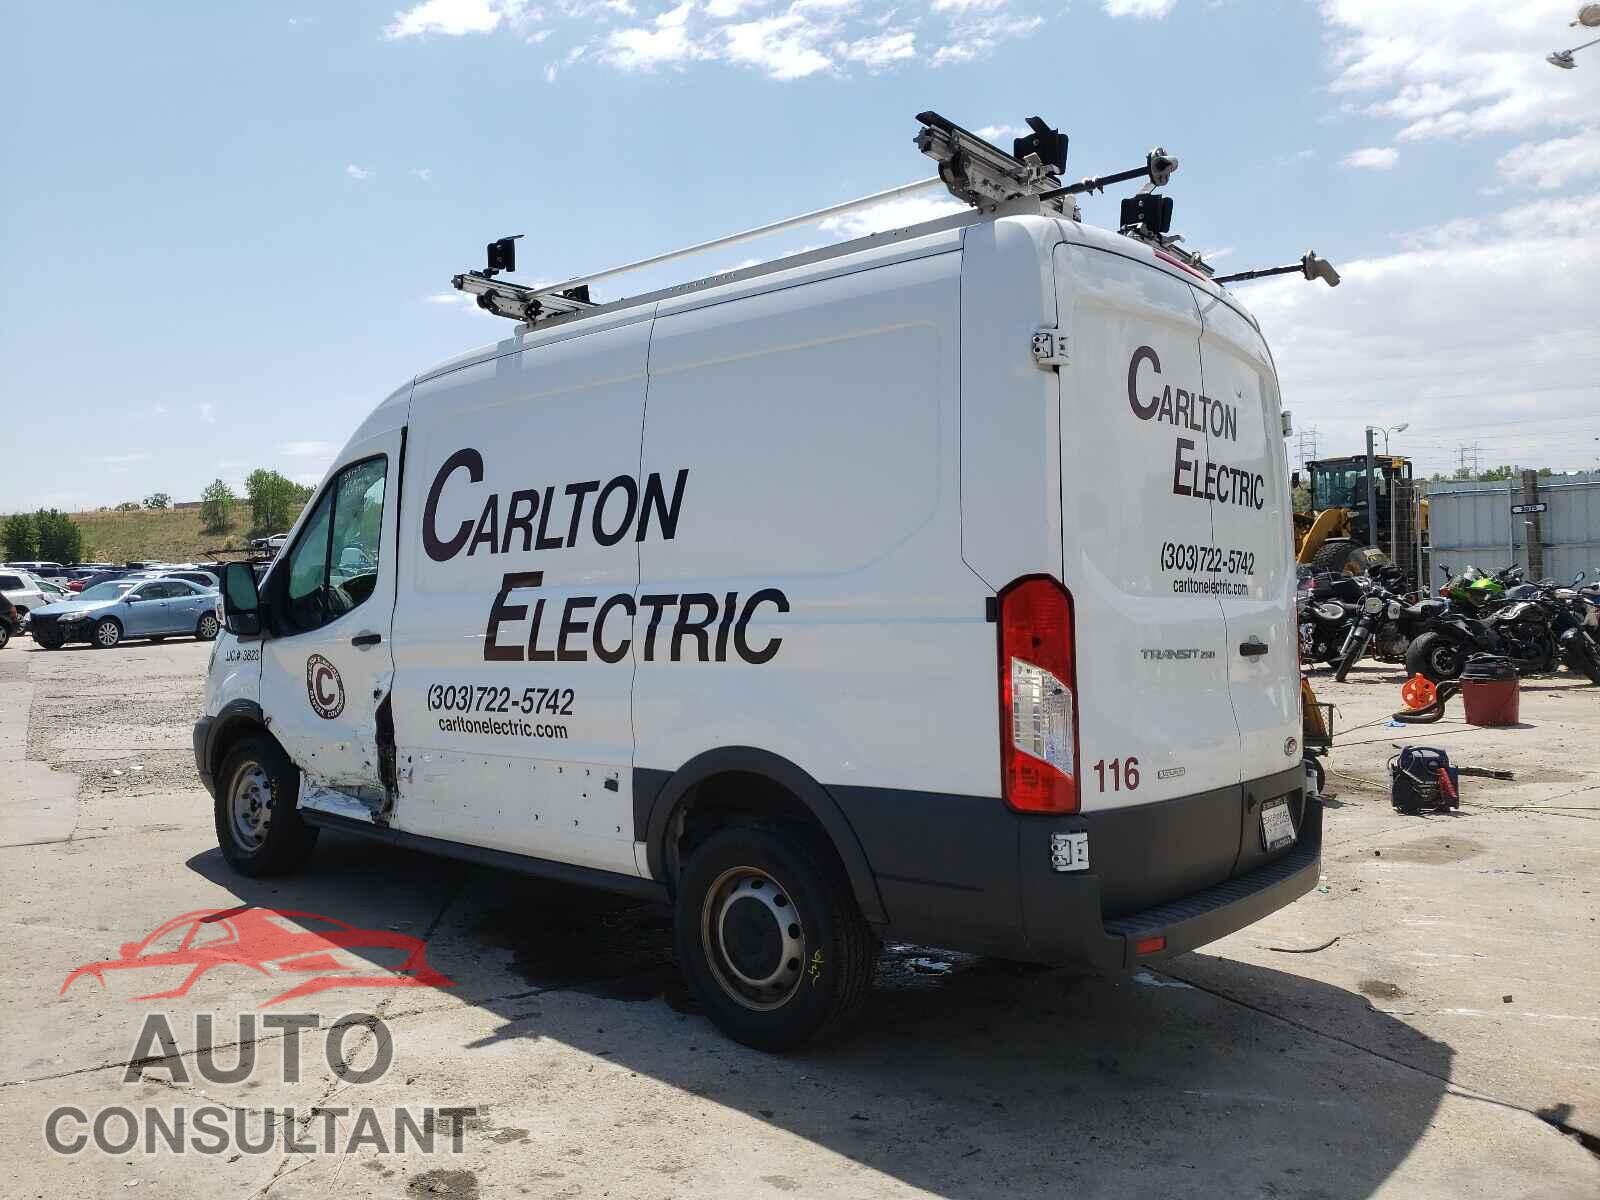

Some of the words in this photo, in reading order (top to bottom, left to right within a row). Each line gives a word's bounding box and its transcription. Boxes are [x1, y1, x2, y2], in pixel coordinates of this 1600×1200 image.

[1127, 345, 1237, 442] CARLTON
[1172, 437, 1264, 511] ELECTRIC
[422, 447, 689, 562] CARLTON
[1160, 541, 1255, 576] (303)722-5742
[1173, 577, 1248, 596] carltonelectric.com
[483, 570, 790, 664] ELECTRIC
[1140, 648, 1200, 660] TRANSIT
[427, 683, 575, 715] (303)722-5742
[438, 715, 568, 739] carltonelectric.com
[1094, 757, 1140, 792] 116
